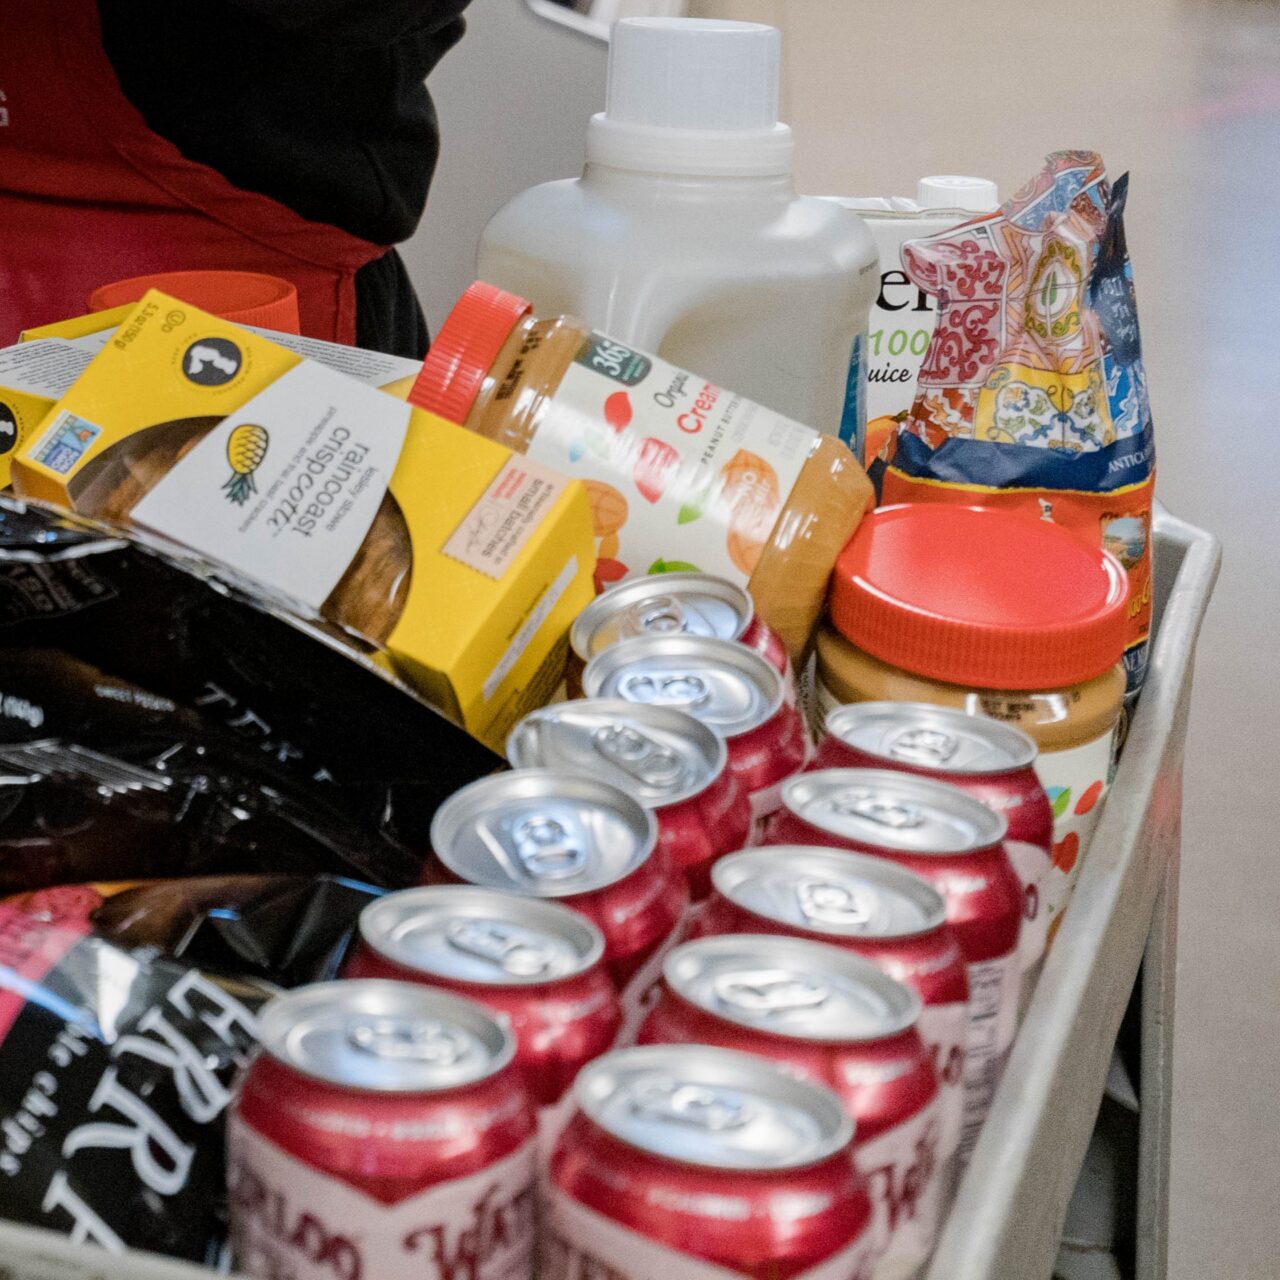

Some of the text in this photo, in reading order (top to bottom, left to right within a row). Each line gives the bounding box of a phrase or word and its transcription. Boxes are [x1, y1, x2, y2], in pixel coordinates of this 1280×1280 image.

[144, 302, 159, 318] 5.3
[593, 340, 632, 376] 365
[867, 362, 912, 383] uice
[701, 425, 726, 465] PEANUT
[238, 405, 337, 532] pineapple and thai basil crackers
[266, 427, 350, 528] crispcotti
[292, 442, 370, 537] raincoast
[326, 467, 378, 532] lesley stowe
[516, 478, 544, 511] small
[481, 510, 522, 558] batches
